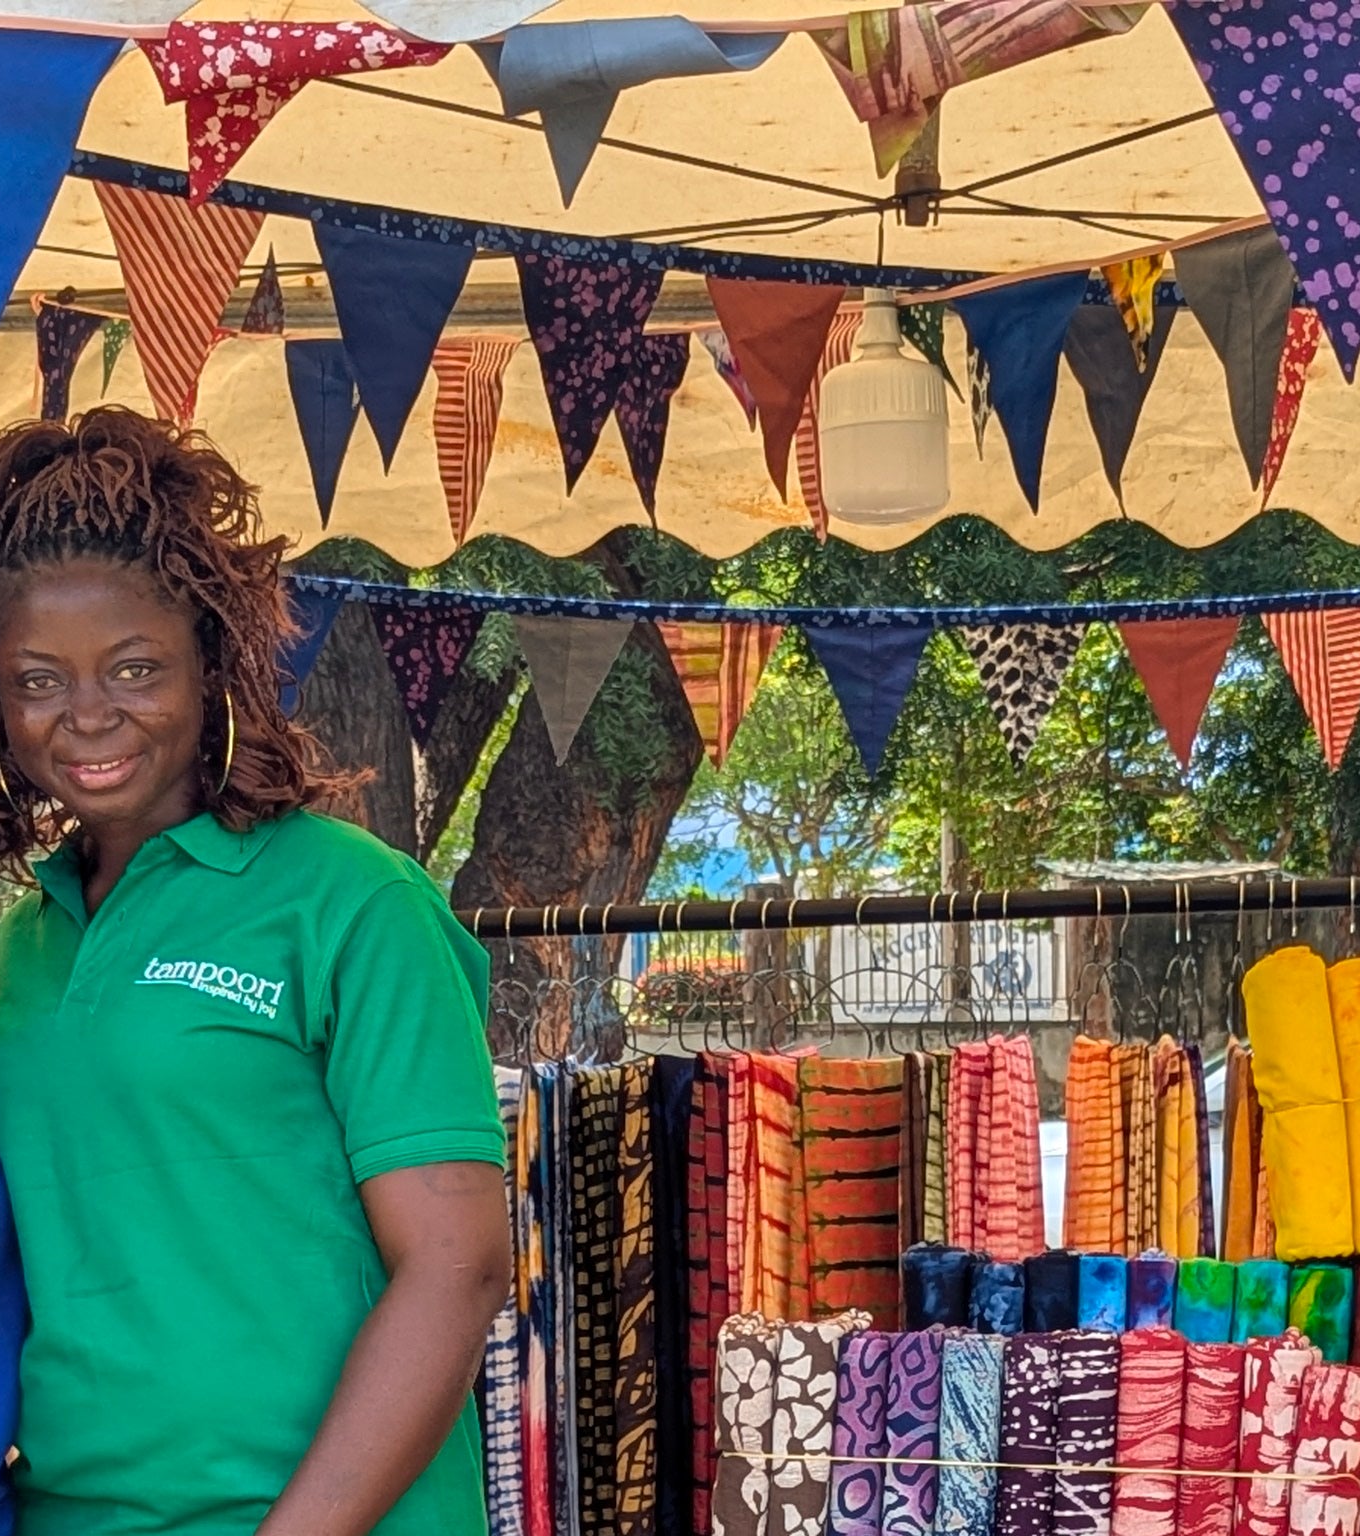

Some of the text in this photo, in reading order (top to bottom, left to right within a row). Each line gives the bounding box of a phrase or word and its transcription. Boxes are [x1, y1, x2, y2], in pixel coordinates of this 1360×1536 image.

[143, 957, 284, 1006] tampoori
[198, 981, 277, 1019] inspired by joy
